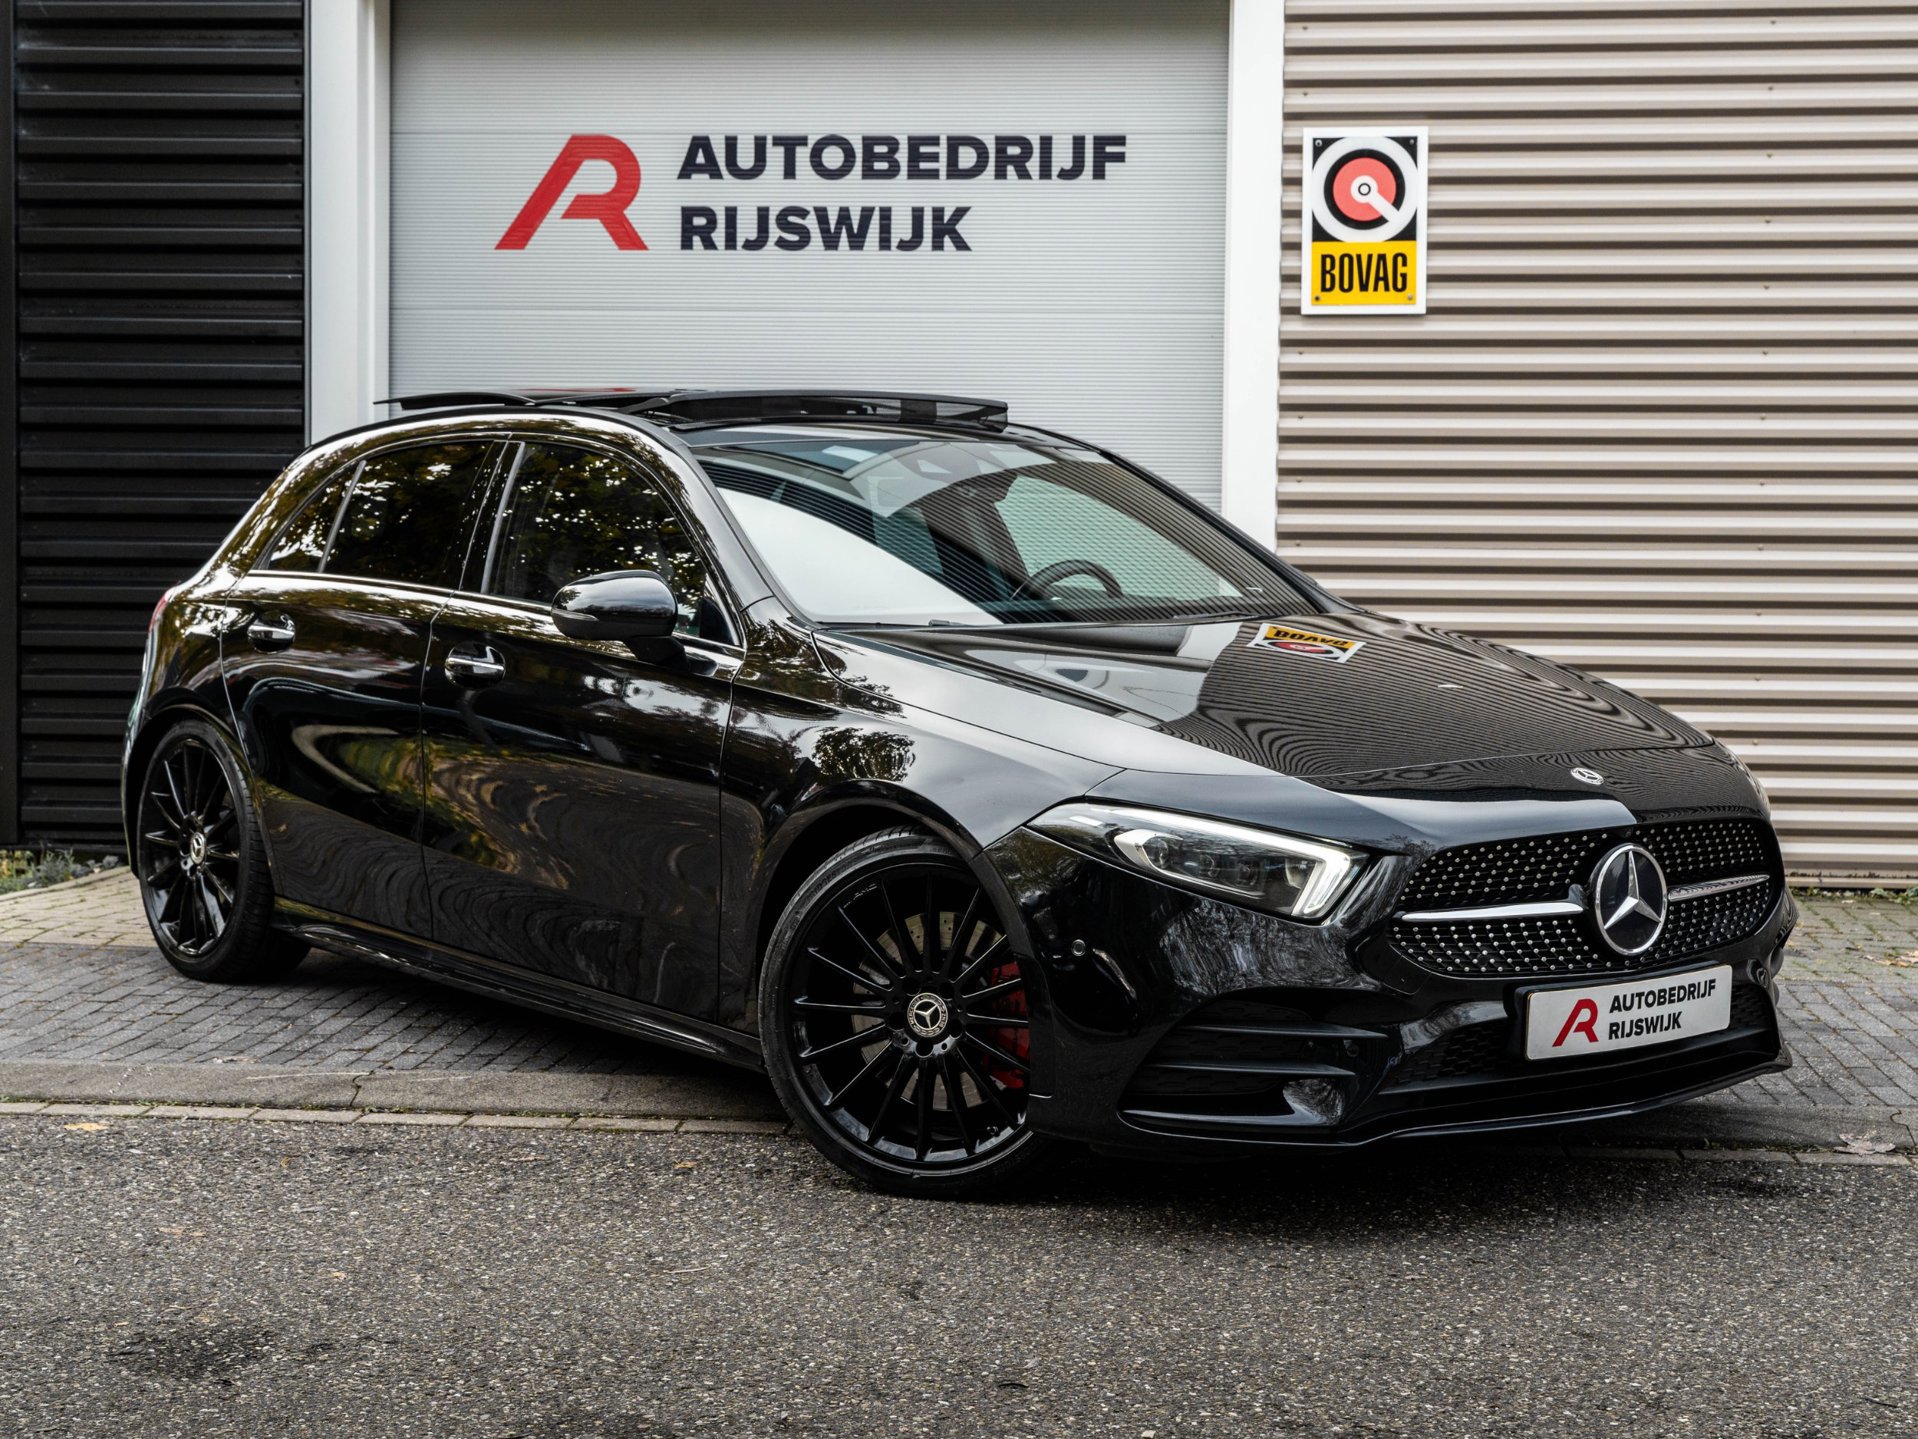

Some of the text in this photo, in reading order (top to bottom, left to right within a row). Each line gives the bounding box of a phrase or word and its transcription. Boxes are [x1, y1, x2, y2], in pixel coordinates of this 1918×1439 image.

[677, 135, 1127, 180] AUTOBEDRIJF
[680, 206, 972, 251] RIJSWIJK
[1320, 252, 1408, 293] BOVAG
[1609, 978, 1716, 1014] AUTOBEDRIJF
[1608, 1011, 1682, 1041] RIJSWIJK
